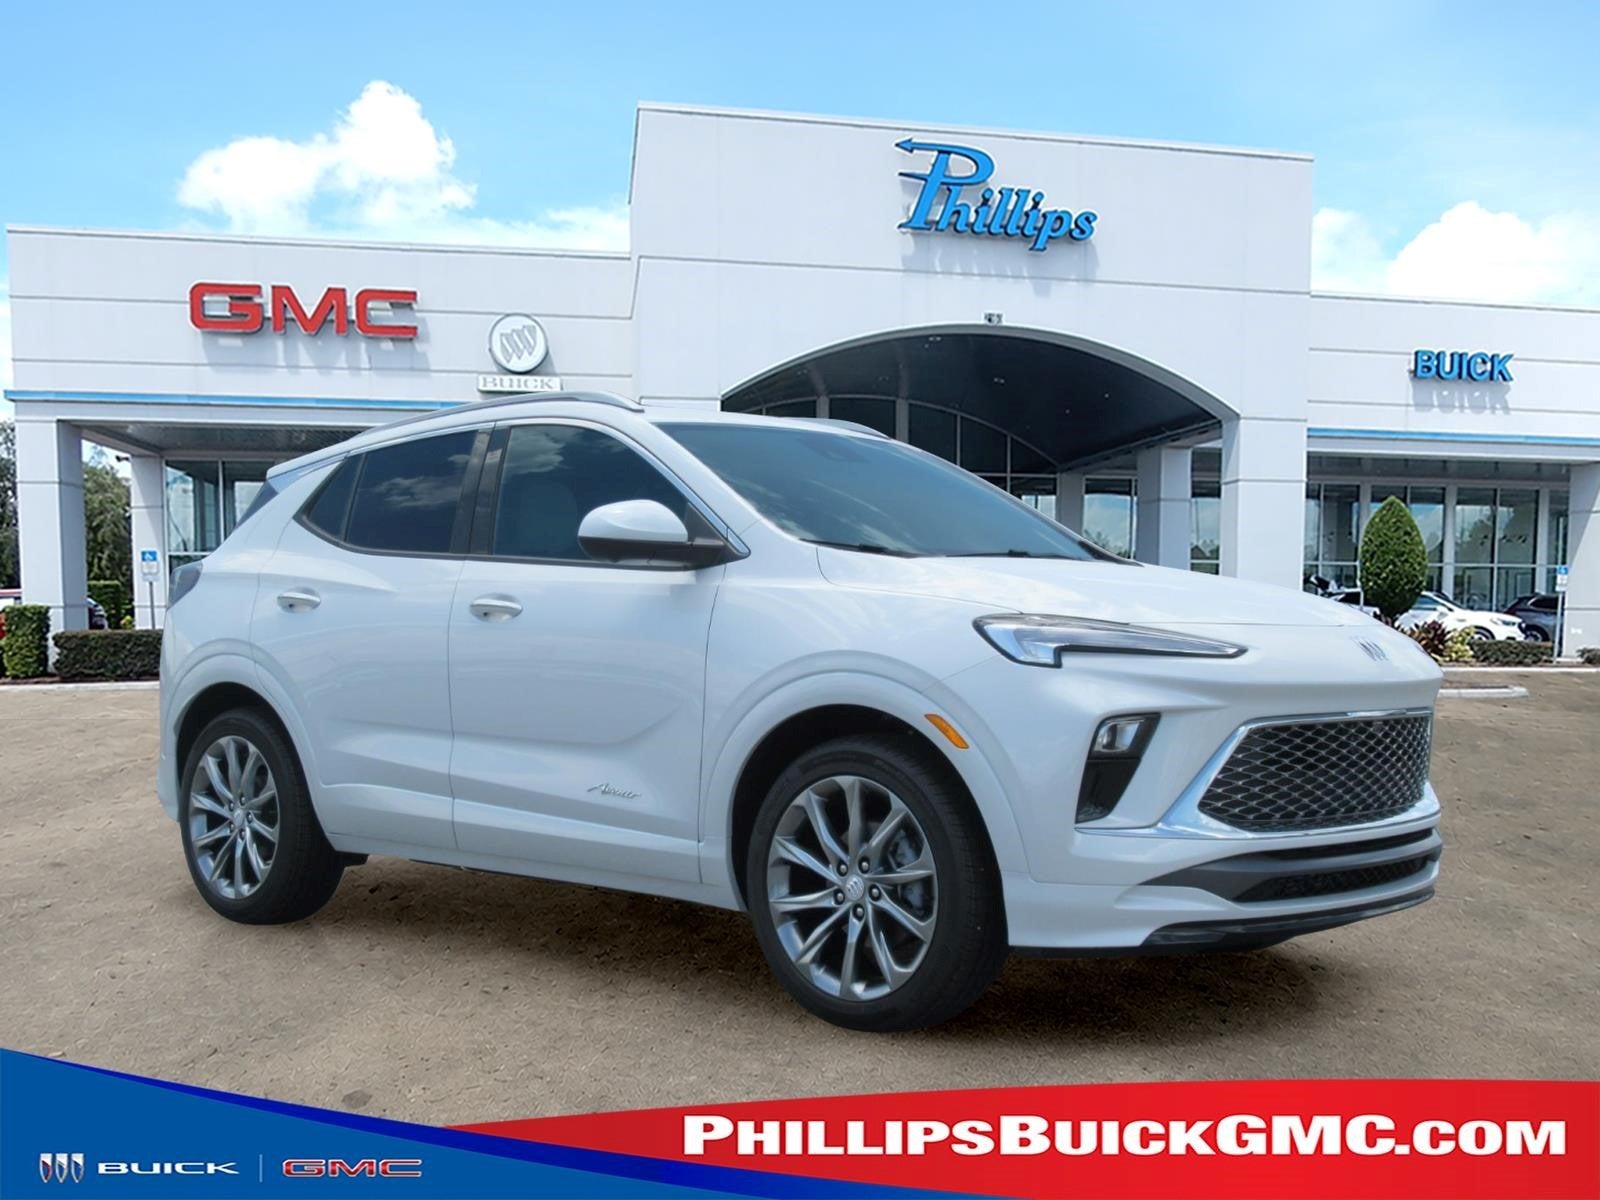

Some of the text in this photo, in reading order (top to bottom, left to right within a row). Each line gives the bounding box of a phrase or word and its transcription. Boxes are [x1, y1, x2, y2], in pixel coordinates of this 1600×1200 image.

[894, 137, 1097, 252] Phillips
[189, 282, 418, 338] GMC
[481, 376, 554, 390] BUICK
[1413, 349, 1514, 383] BUICK
